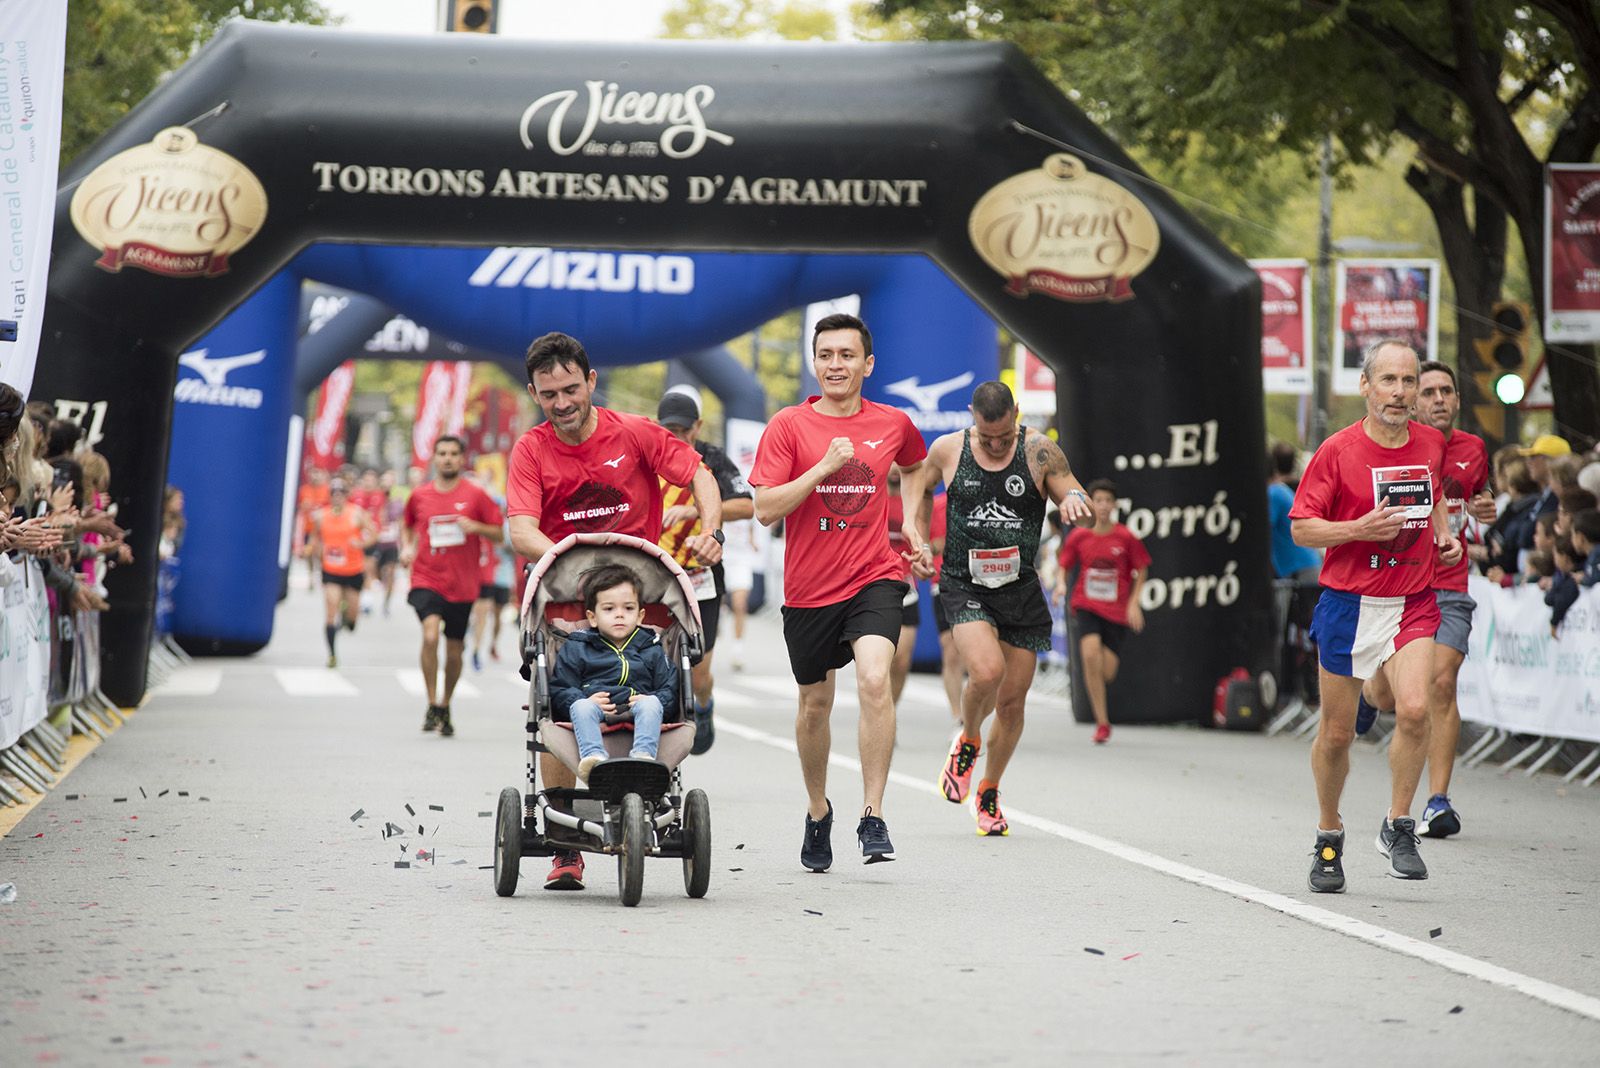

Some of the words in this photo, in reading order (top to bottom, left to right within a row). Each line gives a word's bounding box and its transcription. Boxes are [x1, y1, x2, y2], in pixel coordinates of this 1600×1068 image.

[519, 80, 735, 159] Vicens
[1, 157, 20, 184] de
[312, 161, 486, 197] TORRONS
[490, 168, 670, 203] ARTESANS
[688, 174, 927, 207] D'AGRAMUNT
[3, 191, 25, 272] General
[82, 175, 253, 245] Vicens
[983, 202, 1150, 267] Vicens
[815, 485, 837, 493] SANT
[837, 485, 864, 493] CUGAT
[1388, 485, 1425, 493] CHRISTIAN
[562, 511, 586, 521] SANT
[587, 506, 615, 518] CUGAT
[982, 563, 1011, 573] 2949
[1140, 560, 1240, 611] orró
